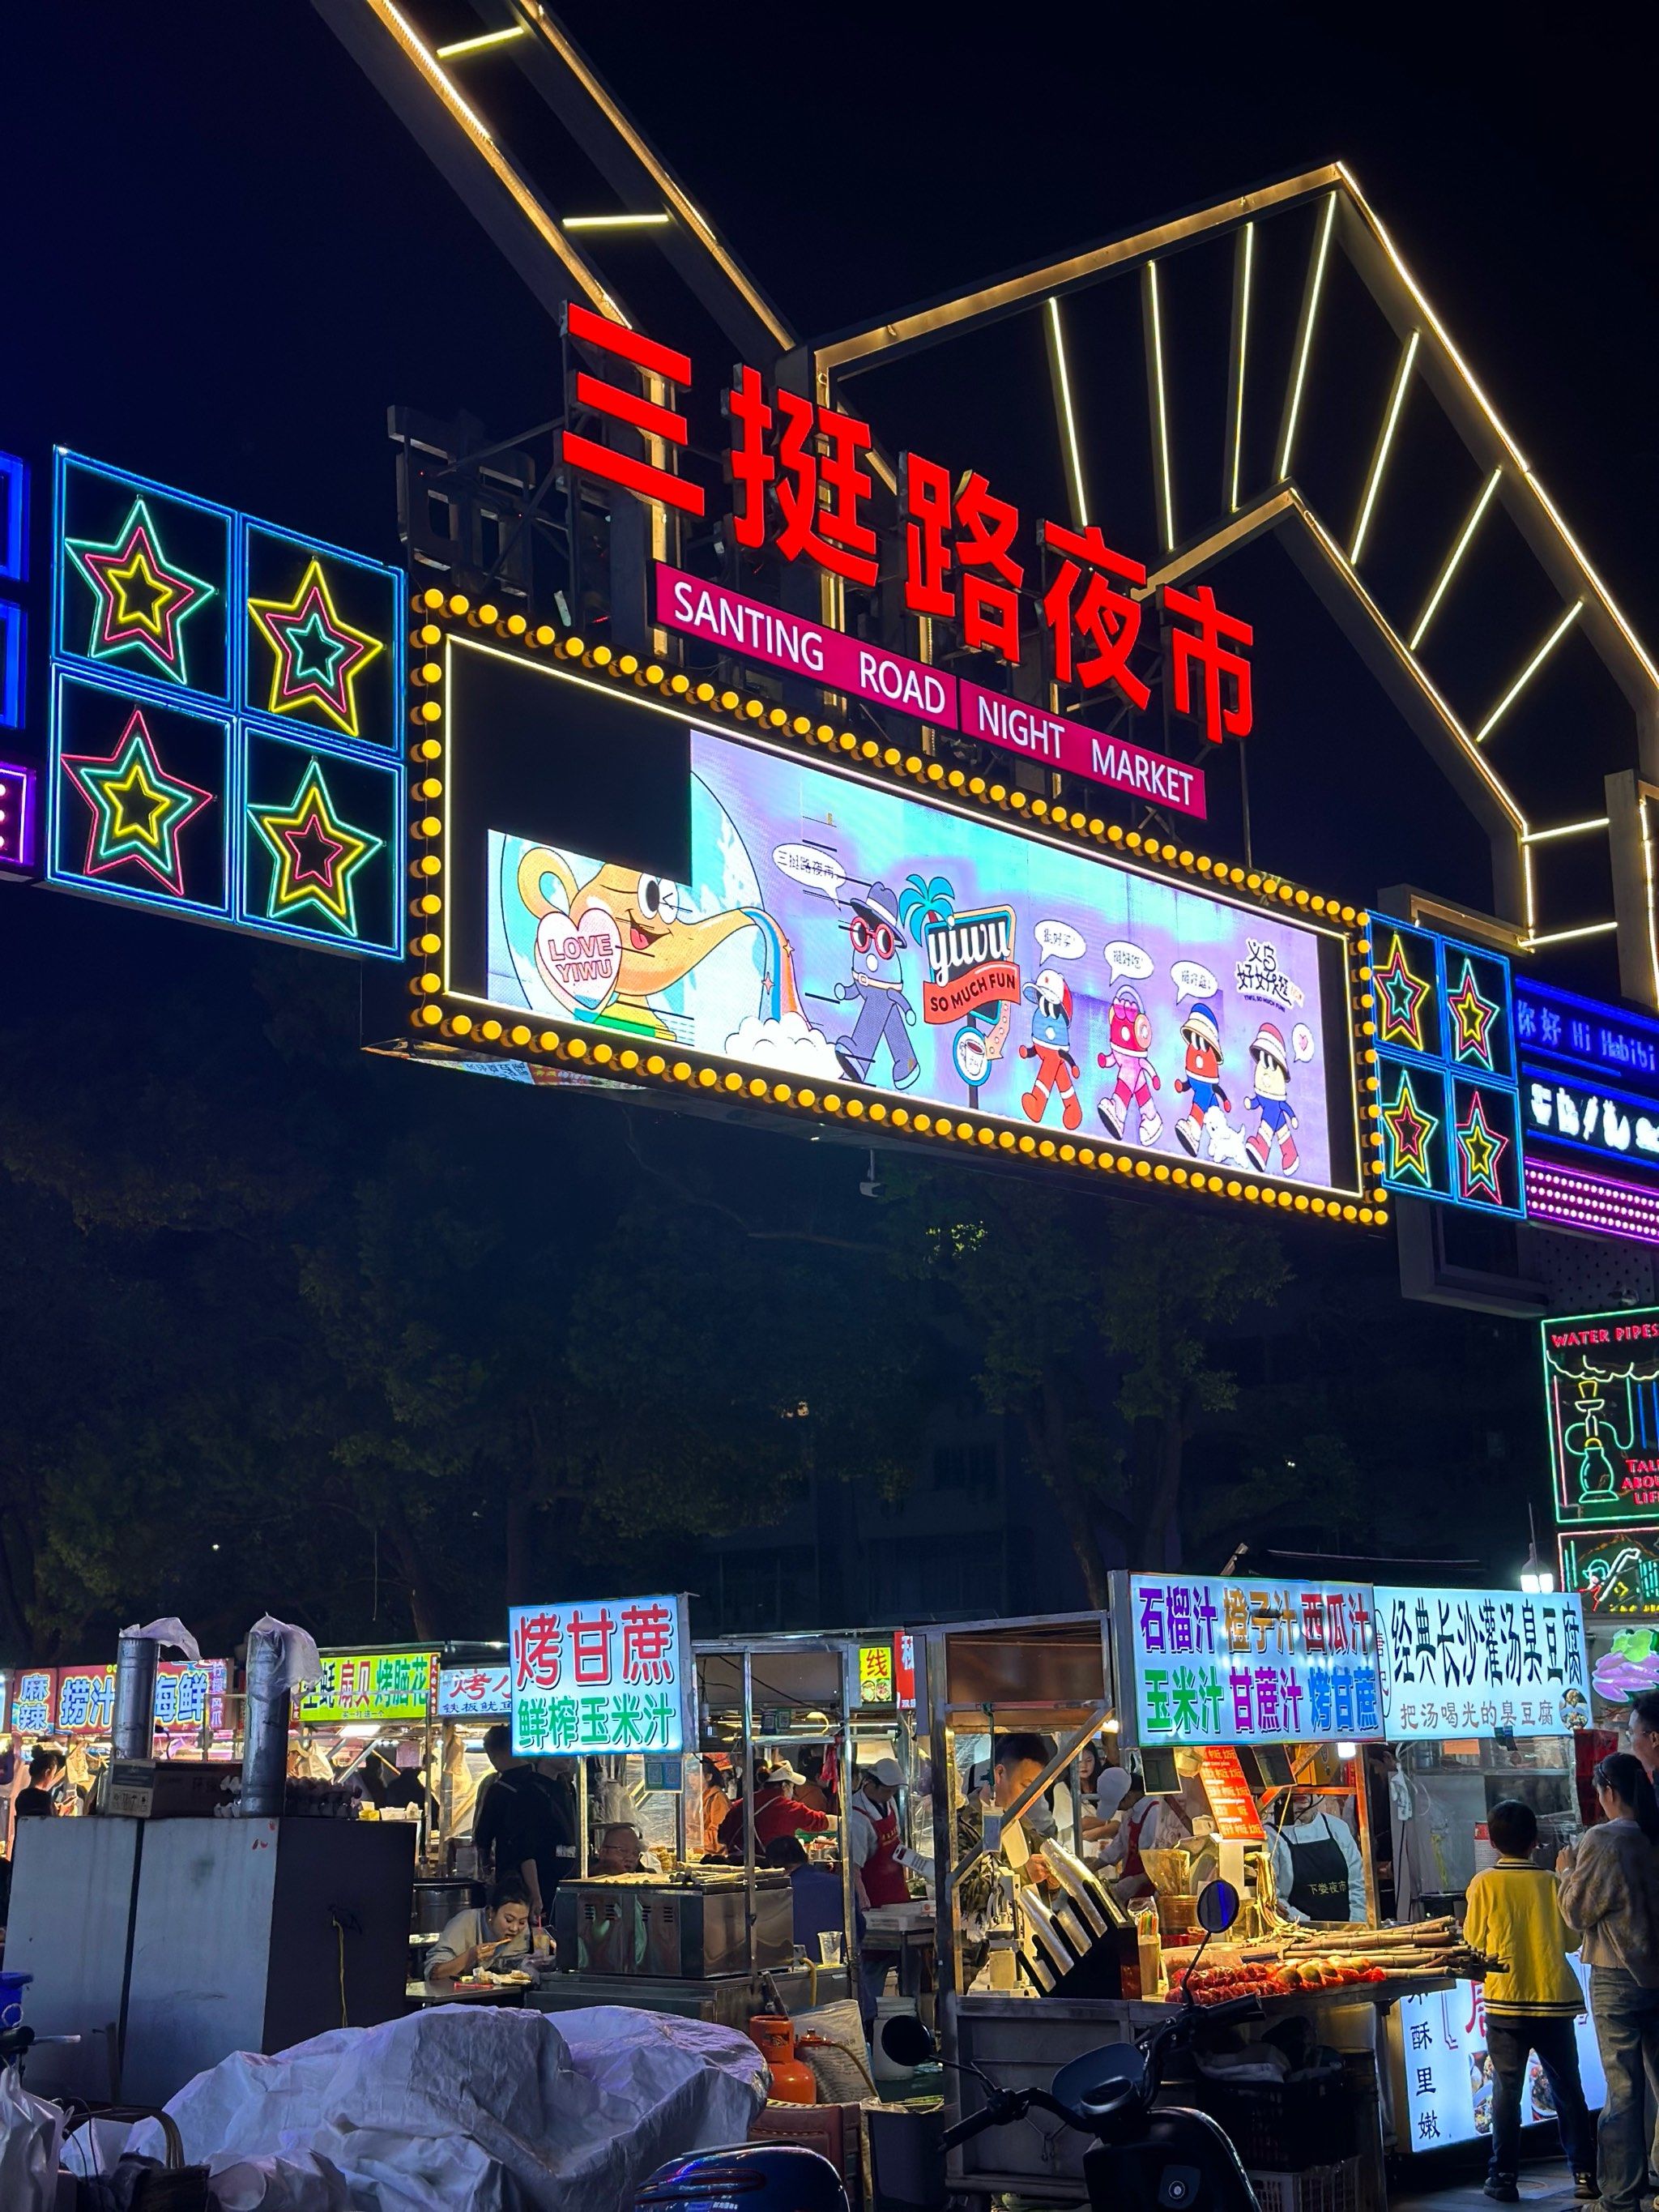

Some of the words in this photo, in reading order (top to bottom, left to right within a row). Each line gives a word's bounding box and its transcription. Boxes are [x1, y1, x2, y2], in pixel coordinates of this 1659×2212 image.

[562, 301, 1254, 745] 三挺路夜市
[674, 582, 824, 672] SANTING
[859, 652, 945, 715] ROAD
[977, 695, 1065, 760] NIGHT
[1091, 740, 1194, 807] MARKET
[548, 933, 613, 961] LOVE
[555, 959, 612, 983] YIWU
[930, 997, 949, 1012] SO
[950, 976, 987, 1010] MUCH
[988, 972, 1016, 989] FUN
[1572, 1021, 1591, 1052] Hi
[1600, 1029, 1656, 1071] Habibi
[1550, 1329, 1610, 1348] WATER
[1614, 1323, 1659, 1342] PIPES
[1633, 1490, 1659, 1505] LIF
[1138, 1585, 1218, 1655] 石榴汁
[1223, 1587, 1298, 1655] 橙子汁
[1300, 1592, 1371, 1655] 西瓜汁
[1391, 1596, 1583, 1689] 经典长沙灌汤臭豆腐
[514, 1603, 675, 1691] 烤甘蔗
[866, 1648, 888, 1677] 线
[19, 1673, 50, 1731] 麻辣
[517, 1692, 676, 1749] 鲜榨玉米汁
[1144, 1665, 1224, 1734] 玉米汁
[1229, 1666, 1303, 1733] 甘蔗汁
[1307, 1666, 1379, 1732] 烤甘蔗
[1400, 1699, 1554, 1731] 把汤喝光的臭豆腐
